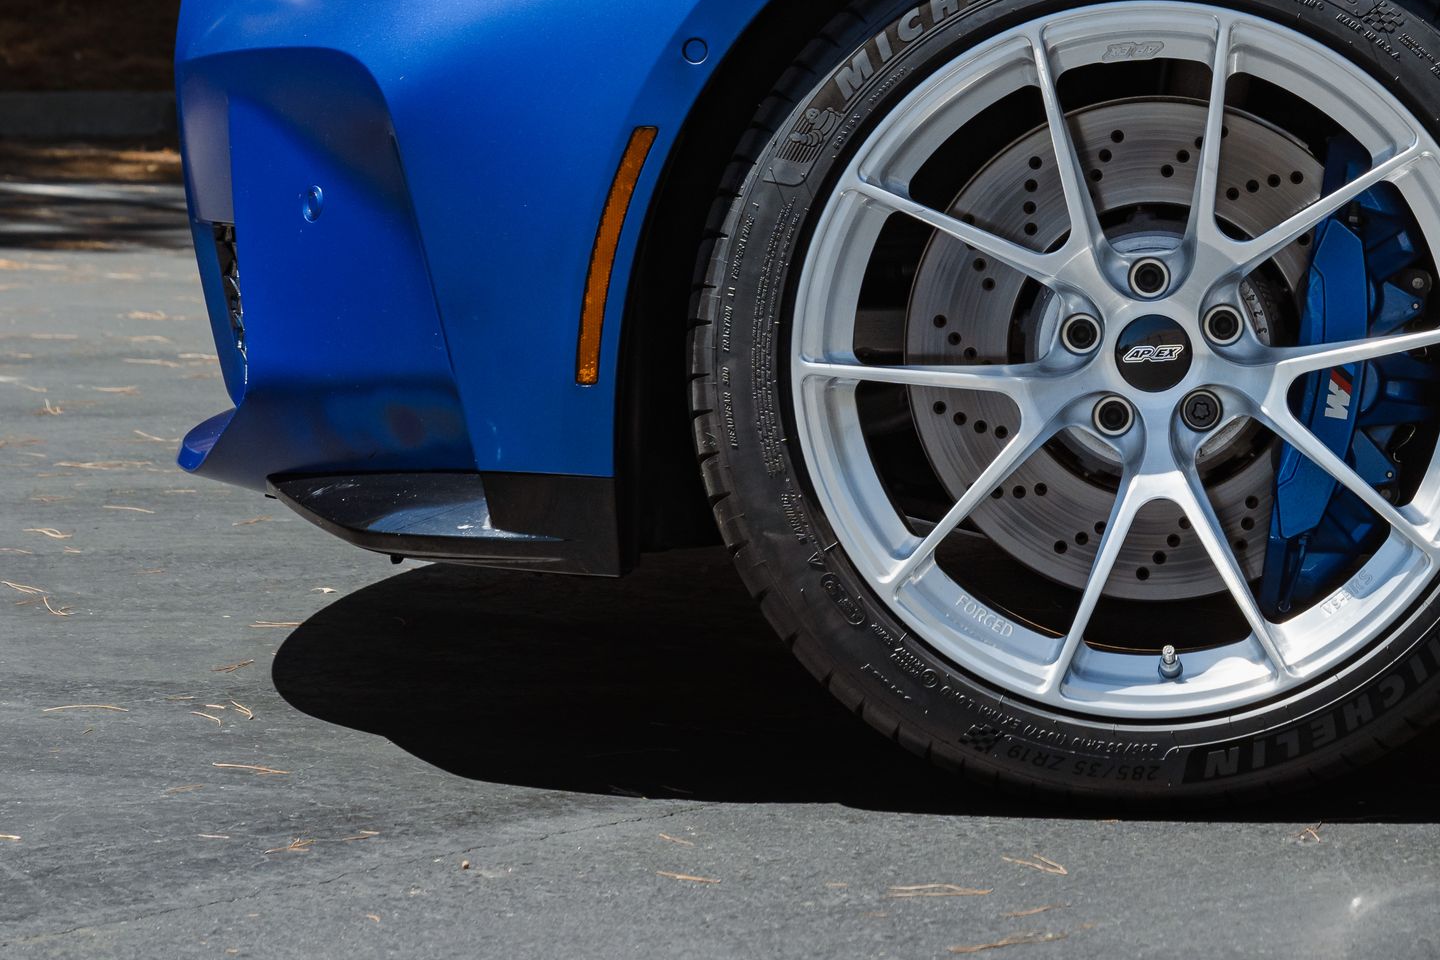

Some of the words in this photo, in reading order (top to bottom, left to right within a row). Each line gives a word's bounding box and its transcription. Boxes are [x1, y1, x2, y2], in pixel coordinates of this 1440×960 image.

[1333, 11, 1363, 34] MADE
[722, 304, 734, 352] TRACTION
[1124, 346, 1183, 362] APEX
[954, 593, 1016, 640] FORGED
[1004, 740, 1066, 773] ZR19
[1071, 757, 1160, 781] 285/35
